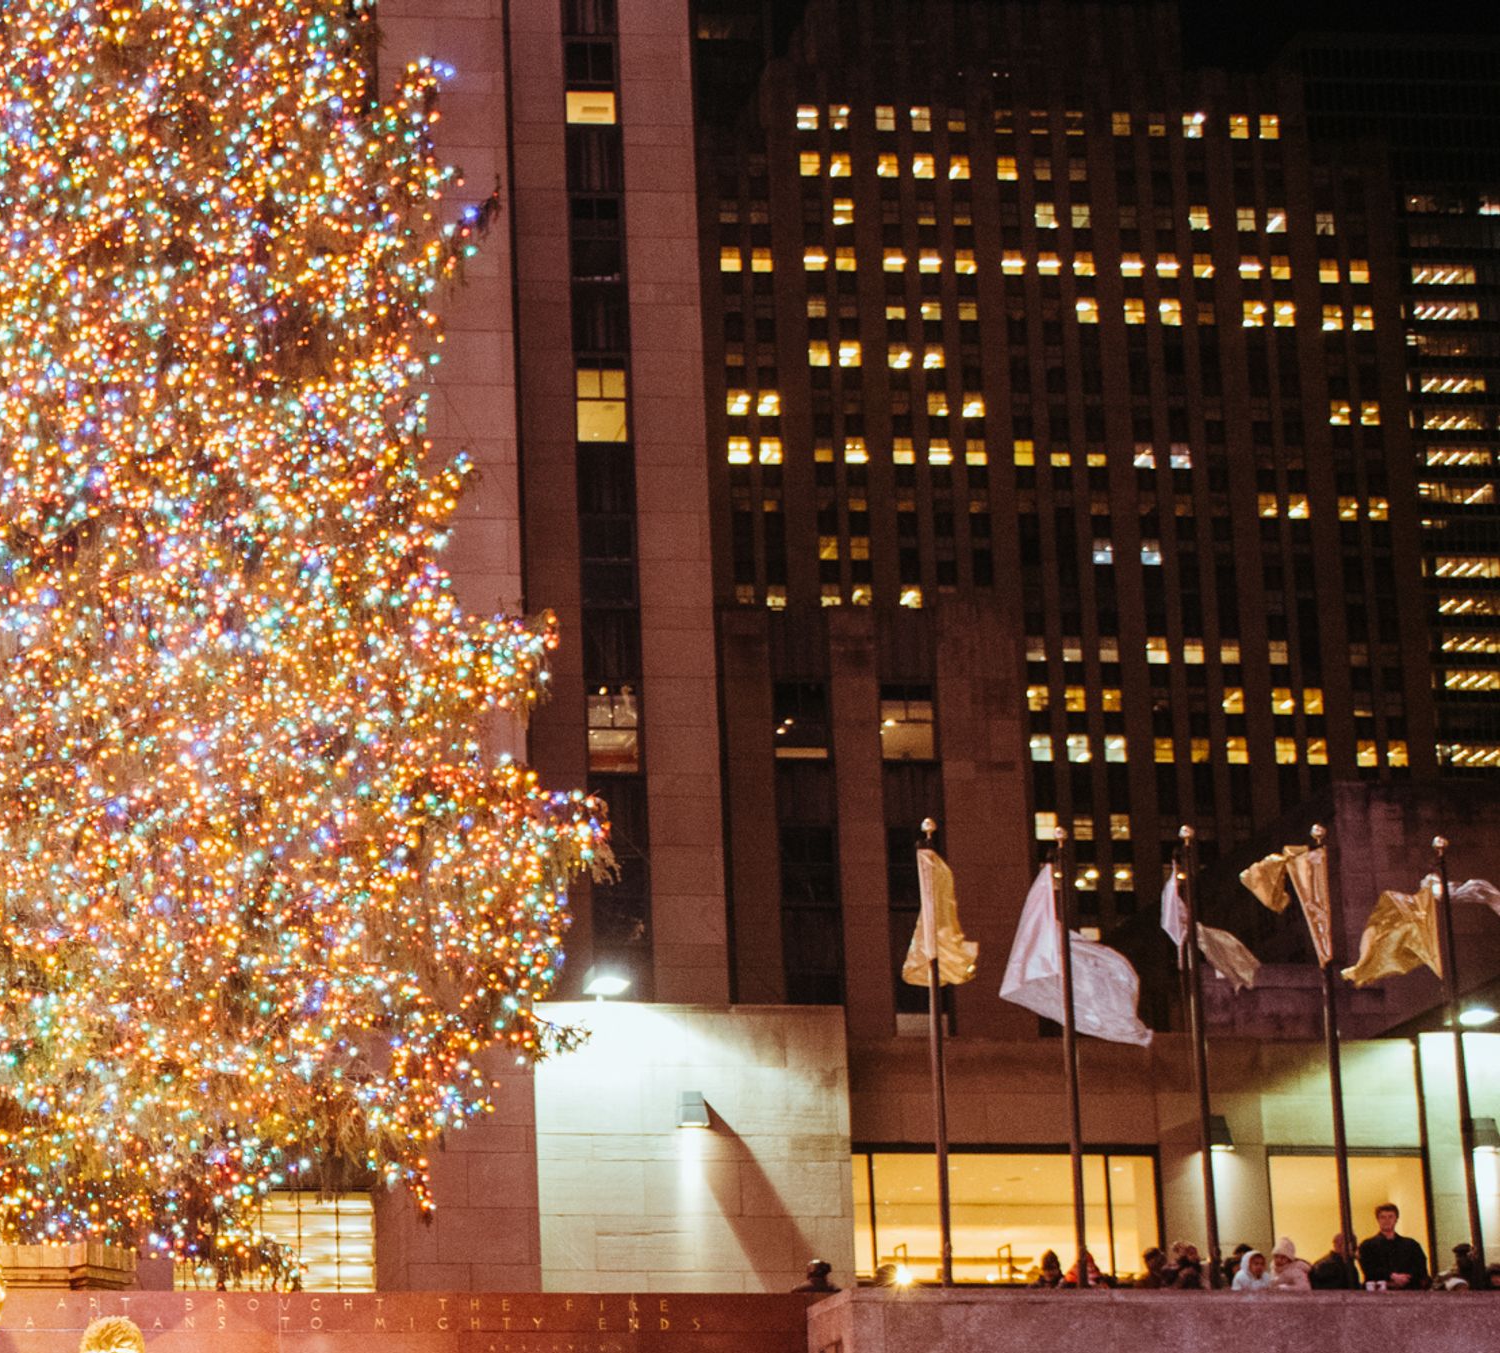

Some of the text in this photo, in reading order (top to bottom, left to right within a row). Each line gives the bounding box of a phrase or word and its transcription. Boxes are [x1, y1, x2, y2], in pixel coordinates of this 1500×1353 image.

[56, 1297, 131, 1310] ART
[184, 1298, 386, 1312] BROUGHT
[438, 1299, 511, 1312] THE
[566, 1299, 669, 1312] FIRE
[281, 1316, 323, 1330] TO
[374, 1316, 543, 1331] MIGHTY
[599, 1317, 701, 1331] ENDS
